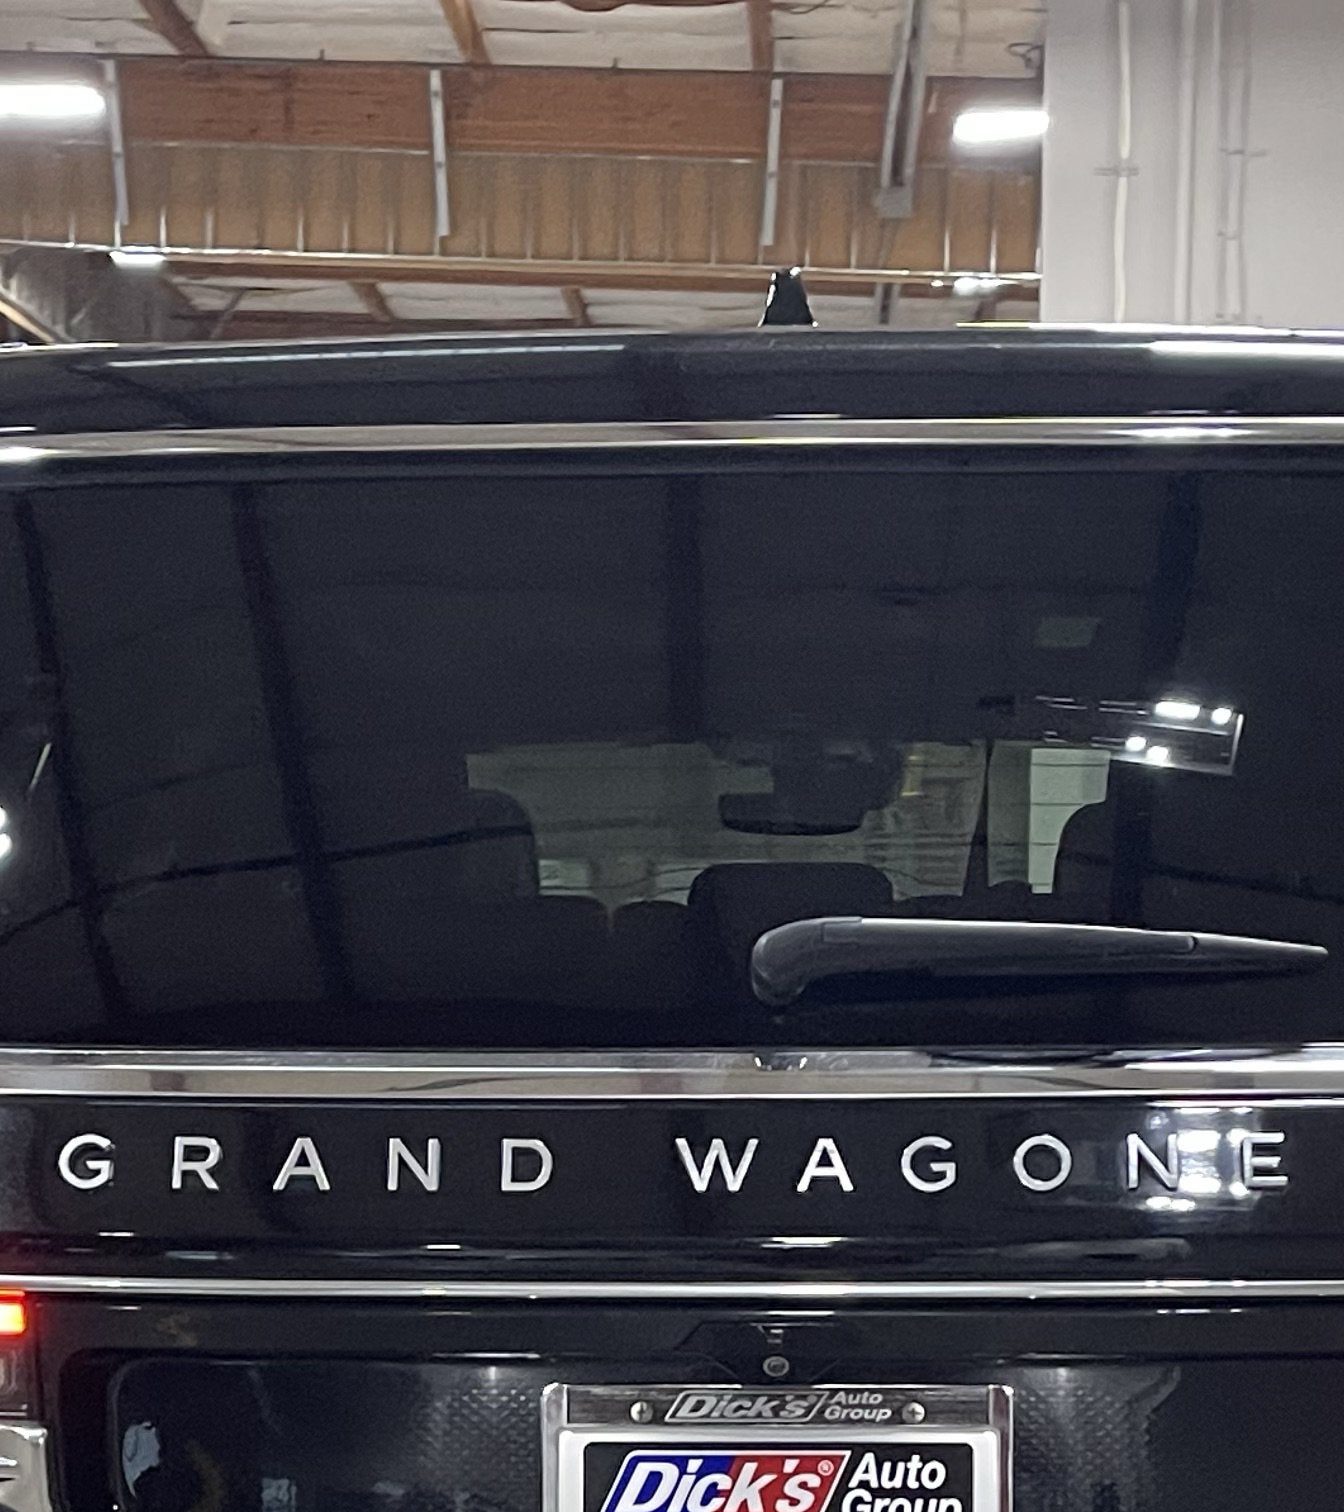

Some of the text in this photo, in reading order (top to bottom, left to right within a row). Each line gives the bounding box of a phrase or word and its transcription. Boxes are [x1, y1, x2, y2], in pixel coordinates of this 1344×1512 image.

[57, 1133, 555, 1193] GRAND
[674, 1394, 809, 1419] Dick's
[829, 1390, 884, 1405] Auto
[823, 1404, 893, 1422] Group
[848, 1451, 947, 1490] Auto
